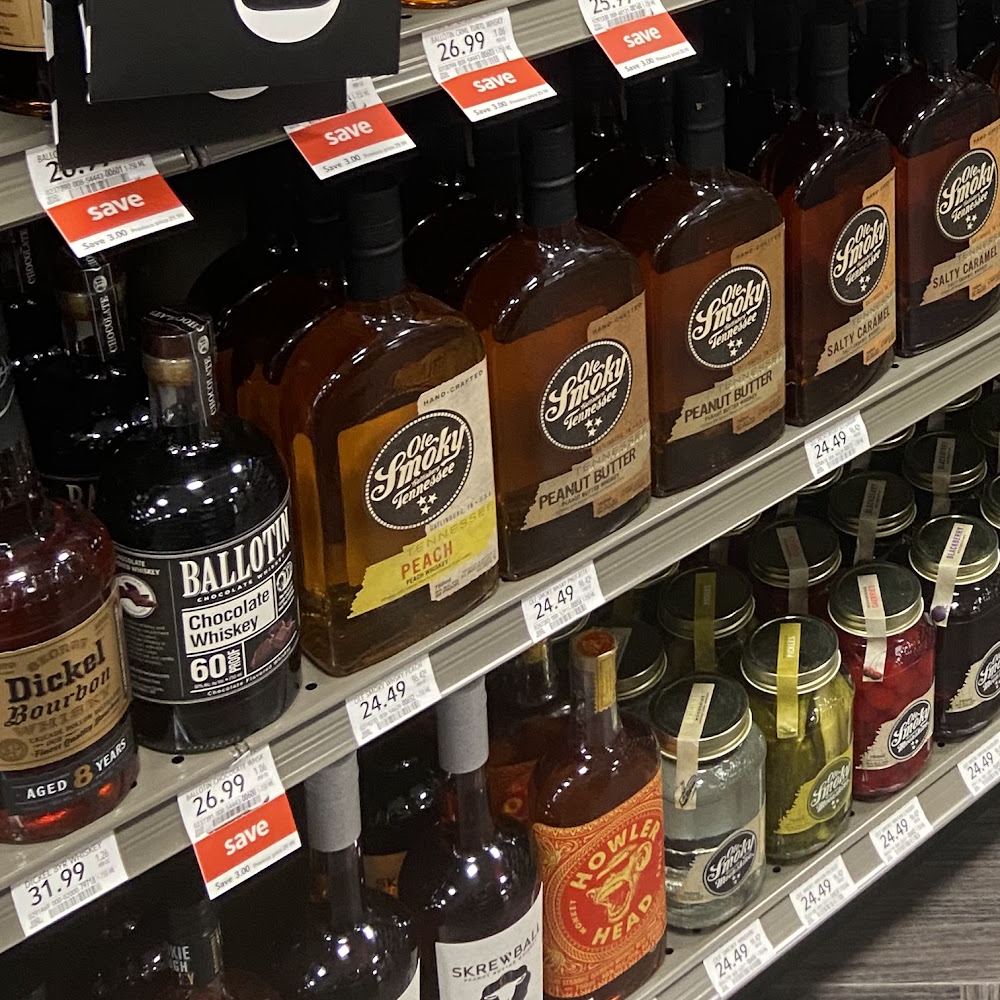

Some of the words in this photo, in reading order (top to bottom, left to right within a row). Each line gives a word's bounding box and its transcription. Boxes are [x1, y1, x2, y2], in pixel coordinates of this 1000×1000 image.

[436, 30, 486, 62] 26.99
[622, 27, 662, 48] save
[472, 70, 517, 93] save
[324, 119, 374, 147] save
[322, 160, 342, 174] Save
[343, 154, 361, 167] 3.00
[87, 192, 146, 222] save
[939, 162, 996, 216] Smoky
[951, 190, 990, 224] Tennessee
[81, 235, 106, 250] Save
[108, 229, 128, 244] 3.00
[834, 219, 888, 280] Smoky
[845, 248, 882, 286] Tennessee
[932, 267, 962, 290] SALTY
[962, 245, 999, 278] CARAMEL
[692, 277, 766, 341] Smoky
[720, 283, 744, 306] Ole
[709, 310, 758, 350] Tennessee
[827, 333, 855, 357] SALTY
[856, 309, 891, 342] CARAMEL
[422, 369, 484, 406] HAND-CRAFTED
[545, 352, 628, 424] Smoky
[576, 359, 604, 384] Ole
[564, 388, 618, 431] Tennessee
[684, 391, 732, 424] PEANUT
[733, 373, 773, 408] BUTTER
[370, 423, 467, 503] Smoky
[407, 432, 435, 456] Ole
[814, 430, 848, 459] 24.49
[392, 461, 455, 508] Tennessee
[539, 475, 591, 510] PEANUT
[592, 447, 637, 488] BUTTER
[178, 509, 291, 600] BALLOTIN
[401, 541, 454, 580] PEACH
[946, 524, 966, 560] BLACKBERRY
[187, 588, 271, 634] Chocolate
[196, 579, 254, 604] CHOCOLATE
[533, 585, 575, 621] 24.49
[190, 614, 260, 650] Whiskey
[6, 639, 107, 702] Dickel
[189, 651, 229, 684] 60
[228, 647, 243, 676] PROOF
[3, 664, 112, 728] Bourbon
[359, 680, 407, 721] 24.49
[25, 779, 68, 801] AGED
[73, 763, 95, 788] 8
[94, 738, 127, 773] YEARS
[967, 751, 994, 779] 24.49
[192, 773, 246, 817] 26.99
[224, 818, 270, 857] save
[879, 818, 909, 849] 24.49
[24, 871, 53, 891] DICKEL
[68, 841, 103, 866] WHISKEY
[570, 818, 662, 891] HOWLER
[27, 861, 87, 906] 31.99
[215, 877, 233, 891] Save
[234, 864, 251, 881] 3.00
[801, 878, 832, 911] 24.49
[592, 891, 654, 947] HEAD
[451, 922, 542, 980] SKREWBALL
[714, 943, 750, 978] 24.49
